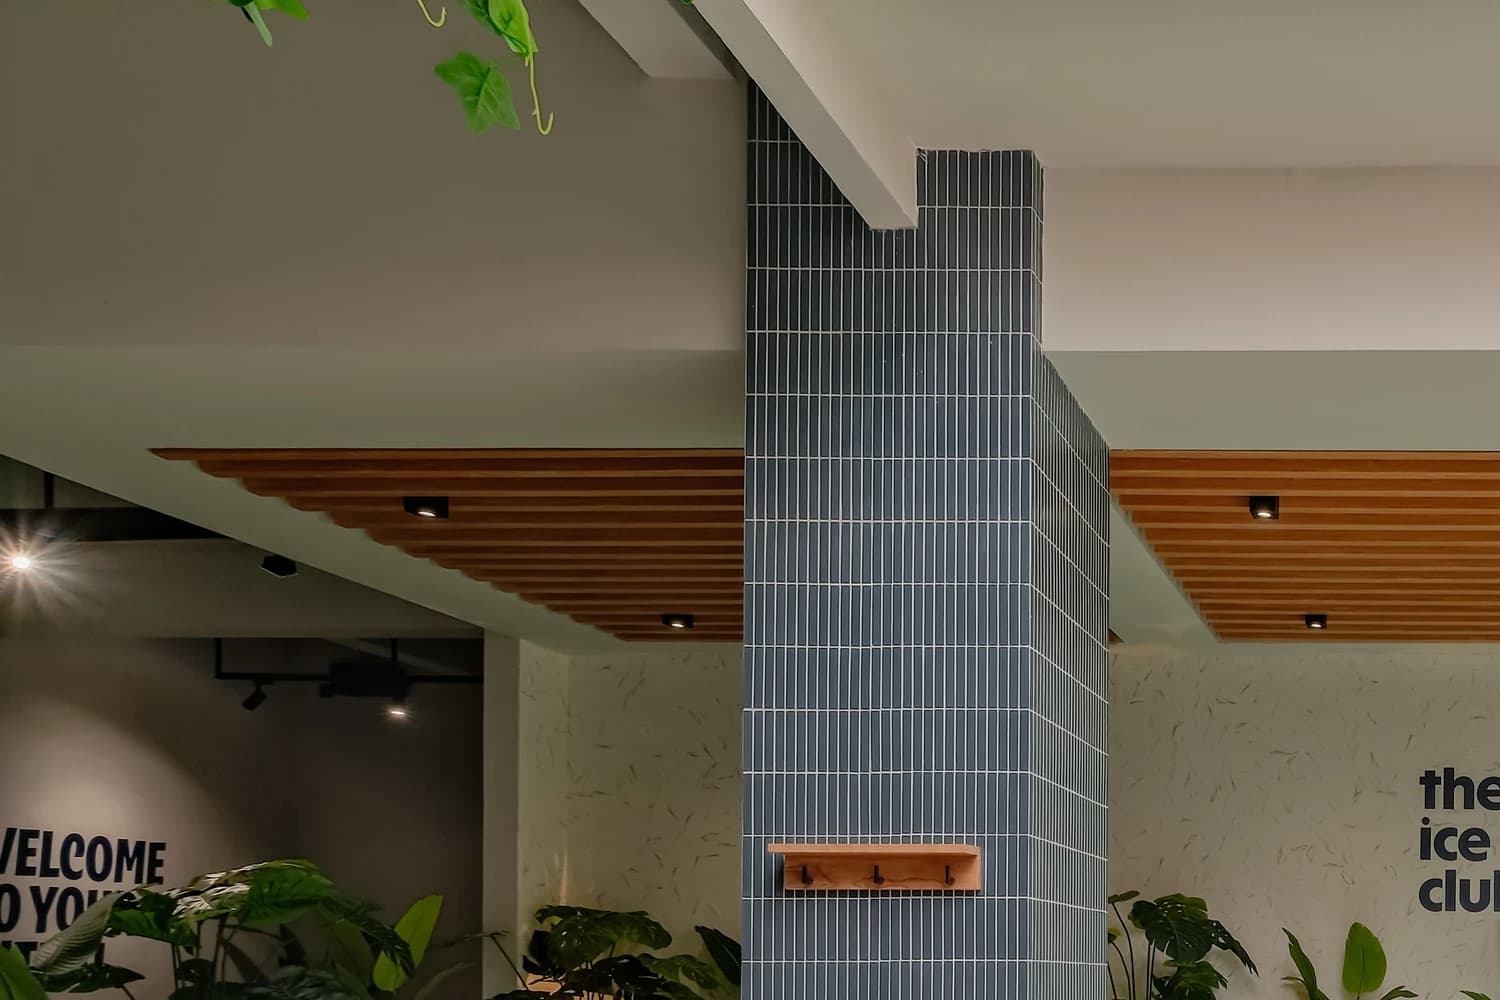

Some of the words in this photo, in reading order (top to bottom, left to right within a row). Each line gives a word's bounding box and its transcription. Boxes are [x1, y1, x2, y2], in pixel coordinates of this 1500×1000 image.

[1419, 816, 1491, 862] ice
[0, 883, 21, 933] O
[29, 886, 124, 934] YO
